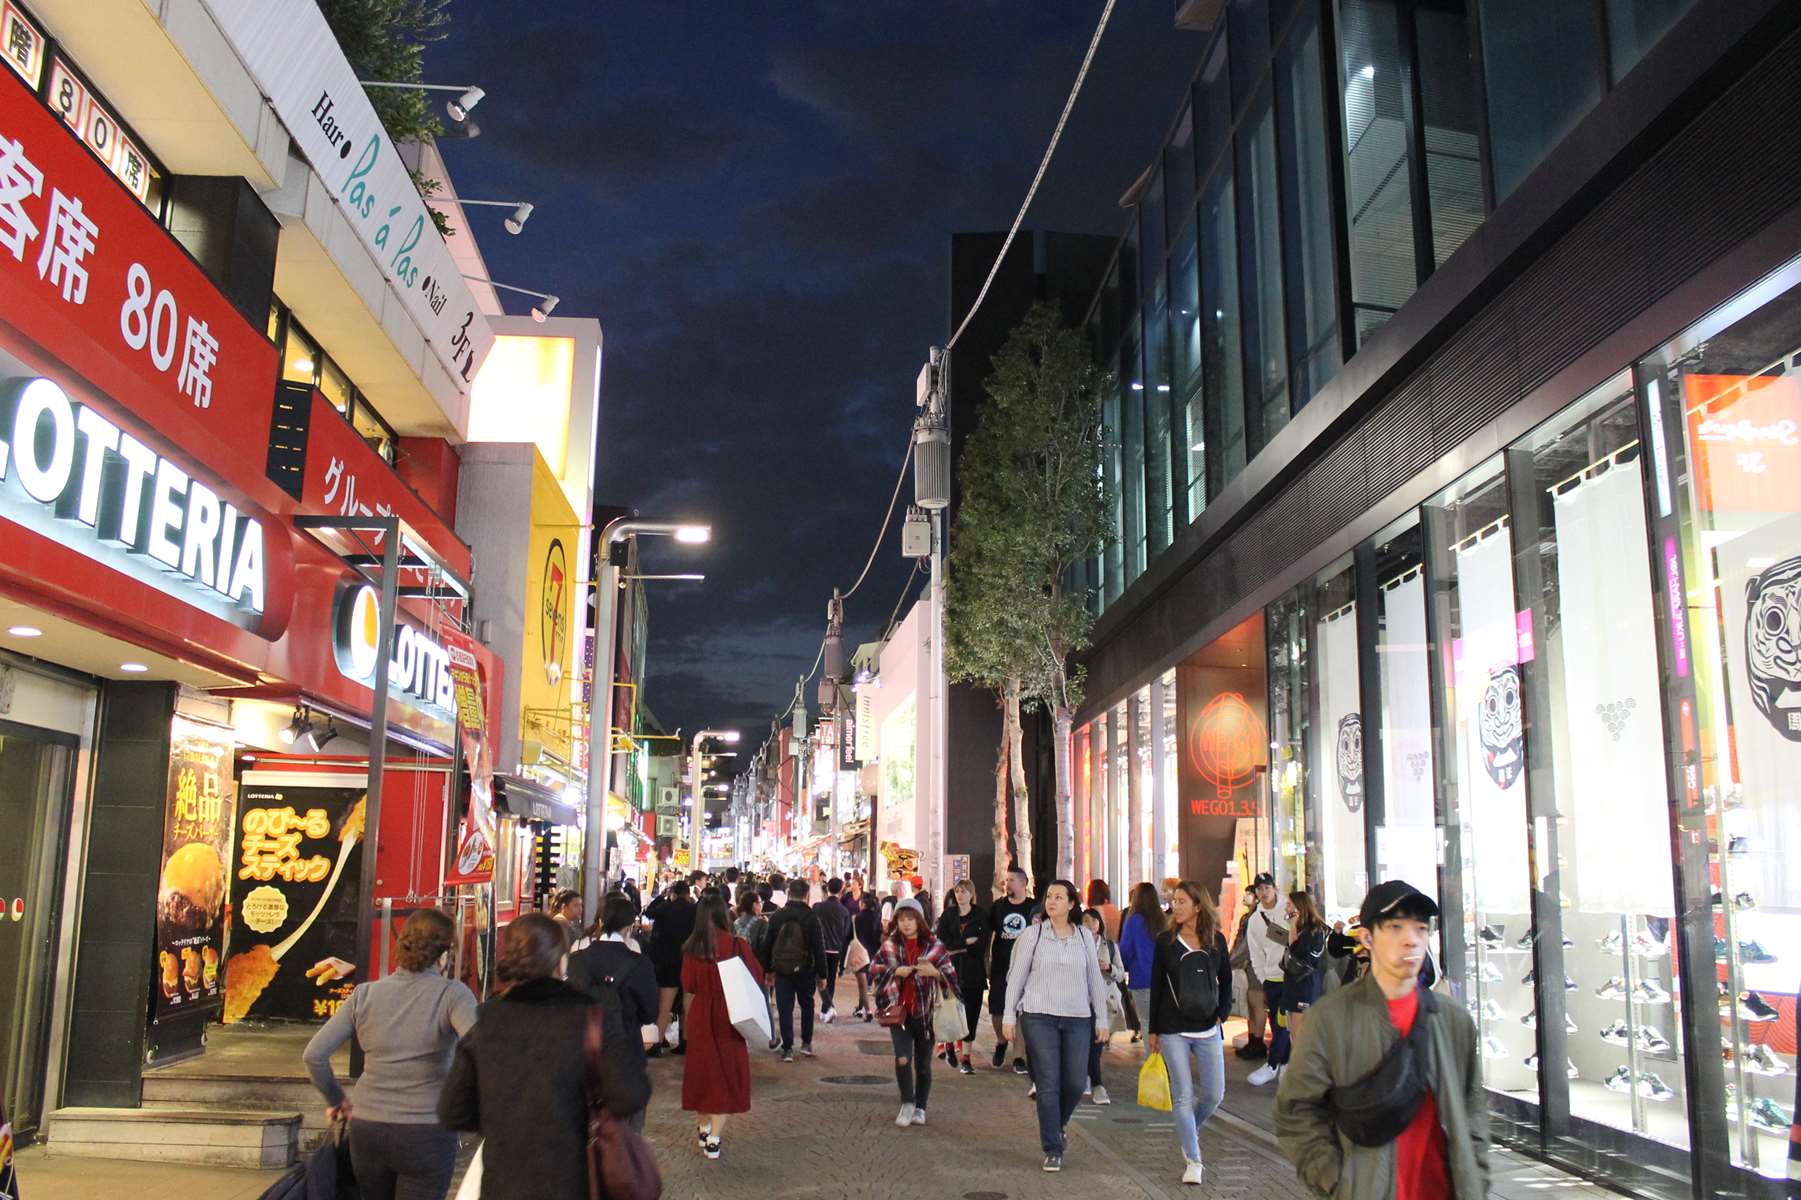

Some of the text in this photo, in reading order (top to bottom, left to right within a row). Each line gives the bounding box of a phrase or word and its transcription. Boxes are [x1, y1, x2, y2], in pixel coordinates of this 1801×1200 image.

[311, 90, 344, 148] Hair
[341, 133, 380, 219] Pas
[391, 214, 425, 289] Pas
[424, 279, 448, 317] Nail
[120, 262, 220, 409] 80席
[845, 719, 855, 763] aimerfeel
[174, 767, 222, 823] 絶品
